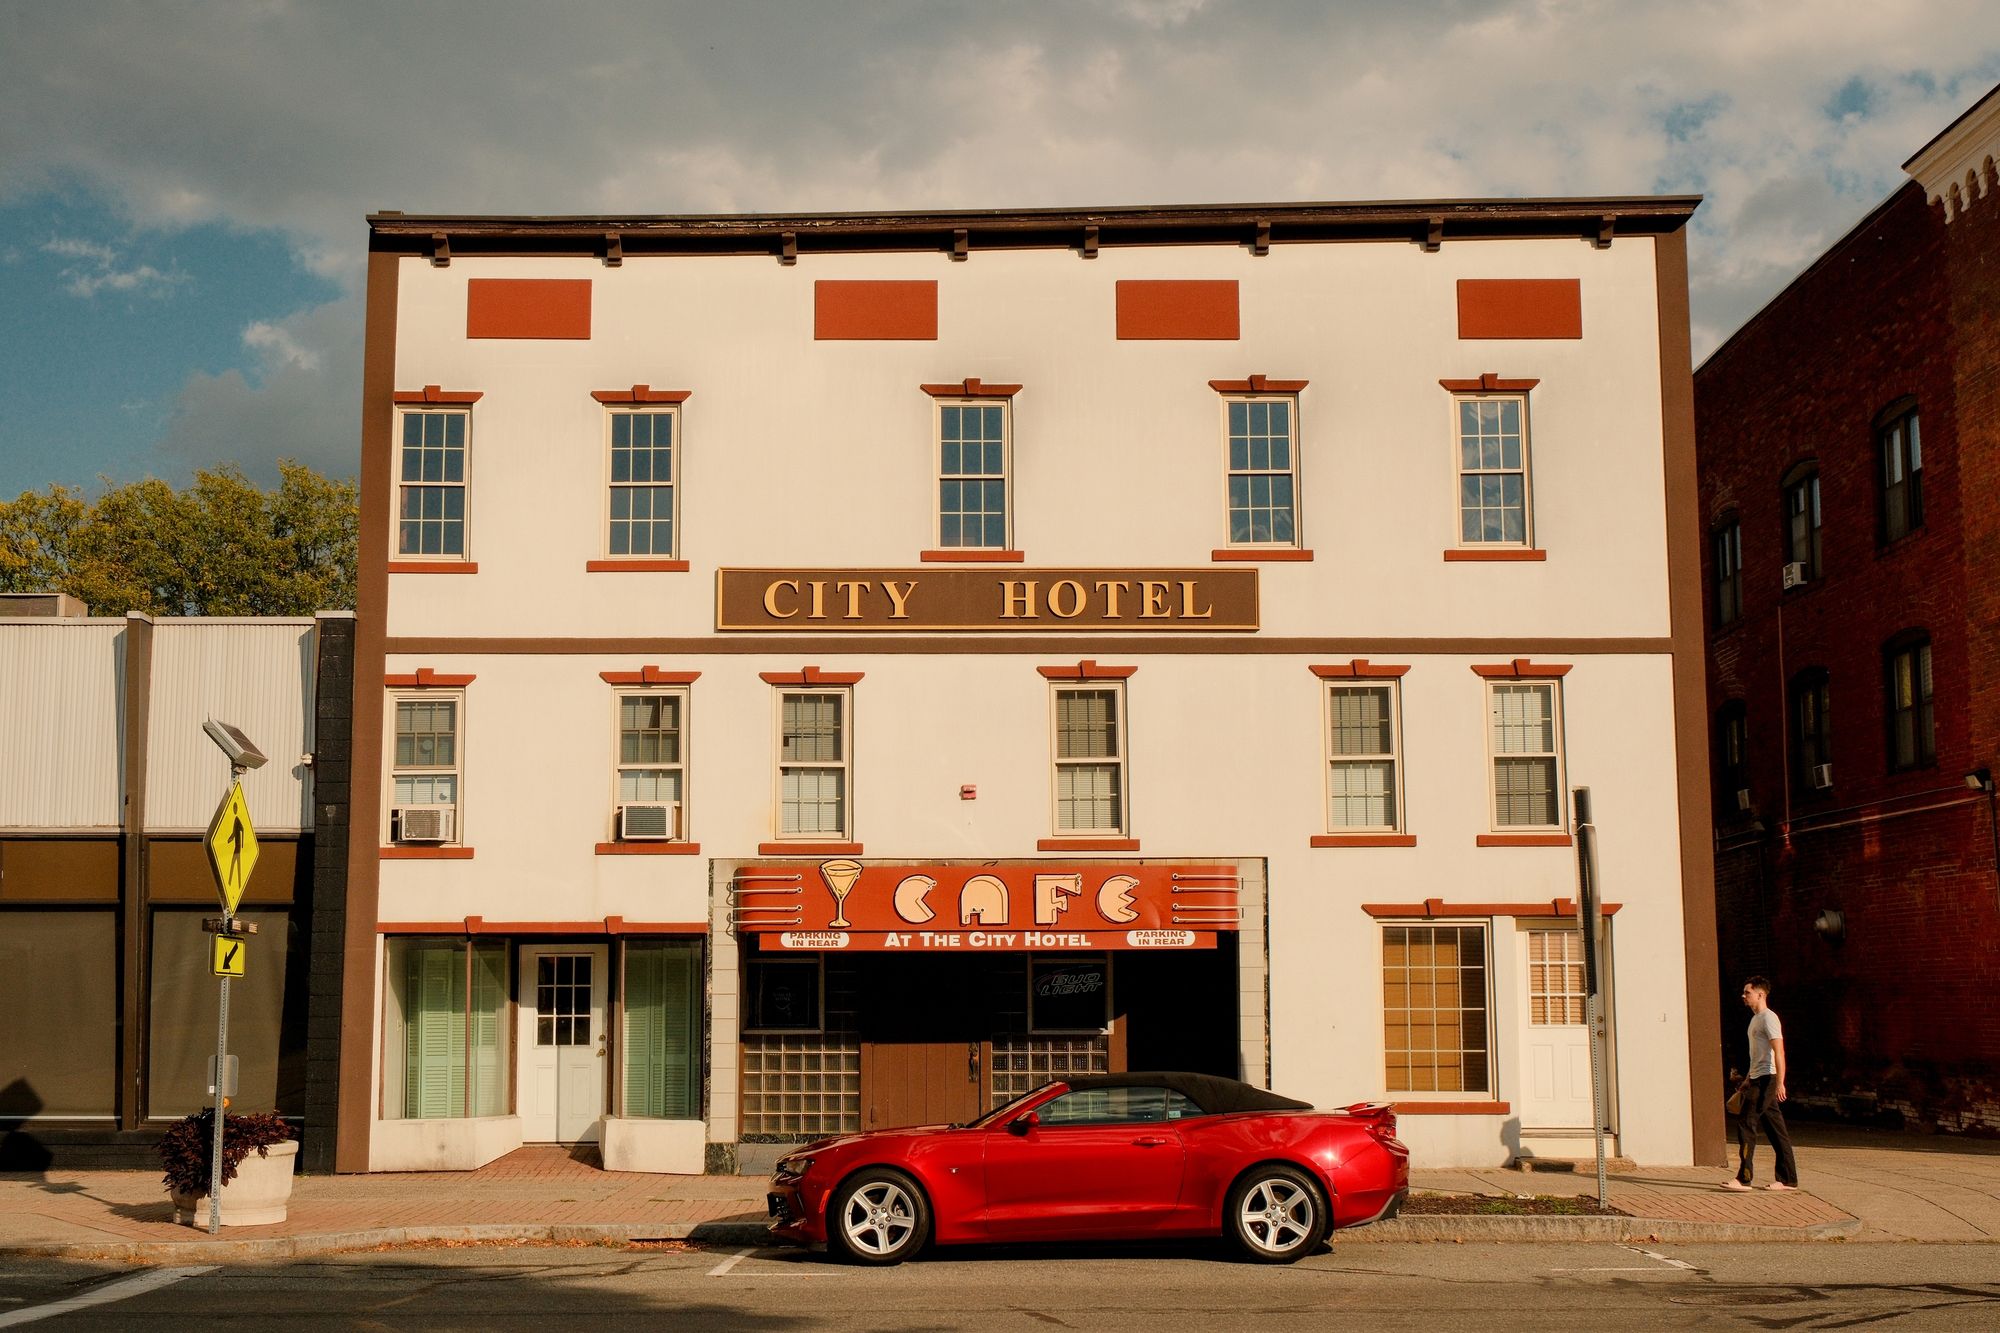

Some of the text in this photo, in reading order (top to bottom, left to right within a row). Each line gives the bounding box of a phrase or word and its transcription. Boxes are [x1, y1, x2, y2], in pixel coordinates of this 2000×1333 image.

[763, 579, 1213, 619] CITY HOTEL
[893, 874, 1141, 926] CAFE
[1040, 981, 1103, 996] LIGHT
[1051, 973, 1101, 986] BUD
